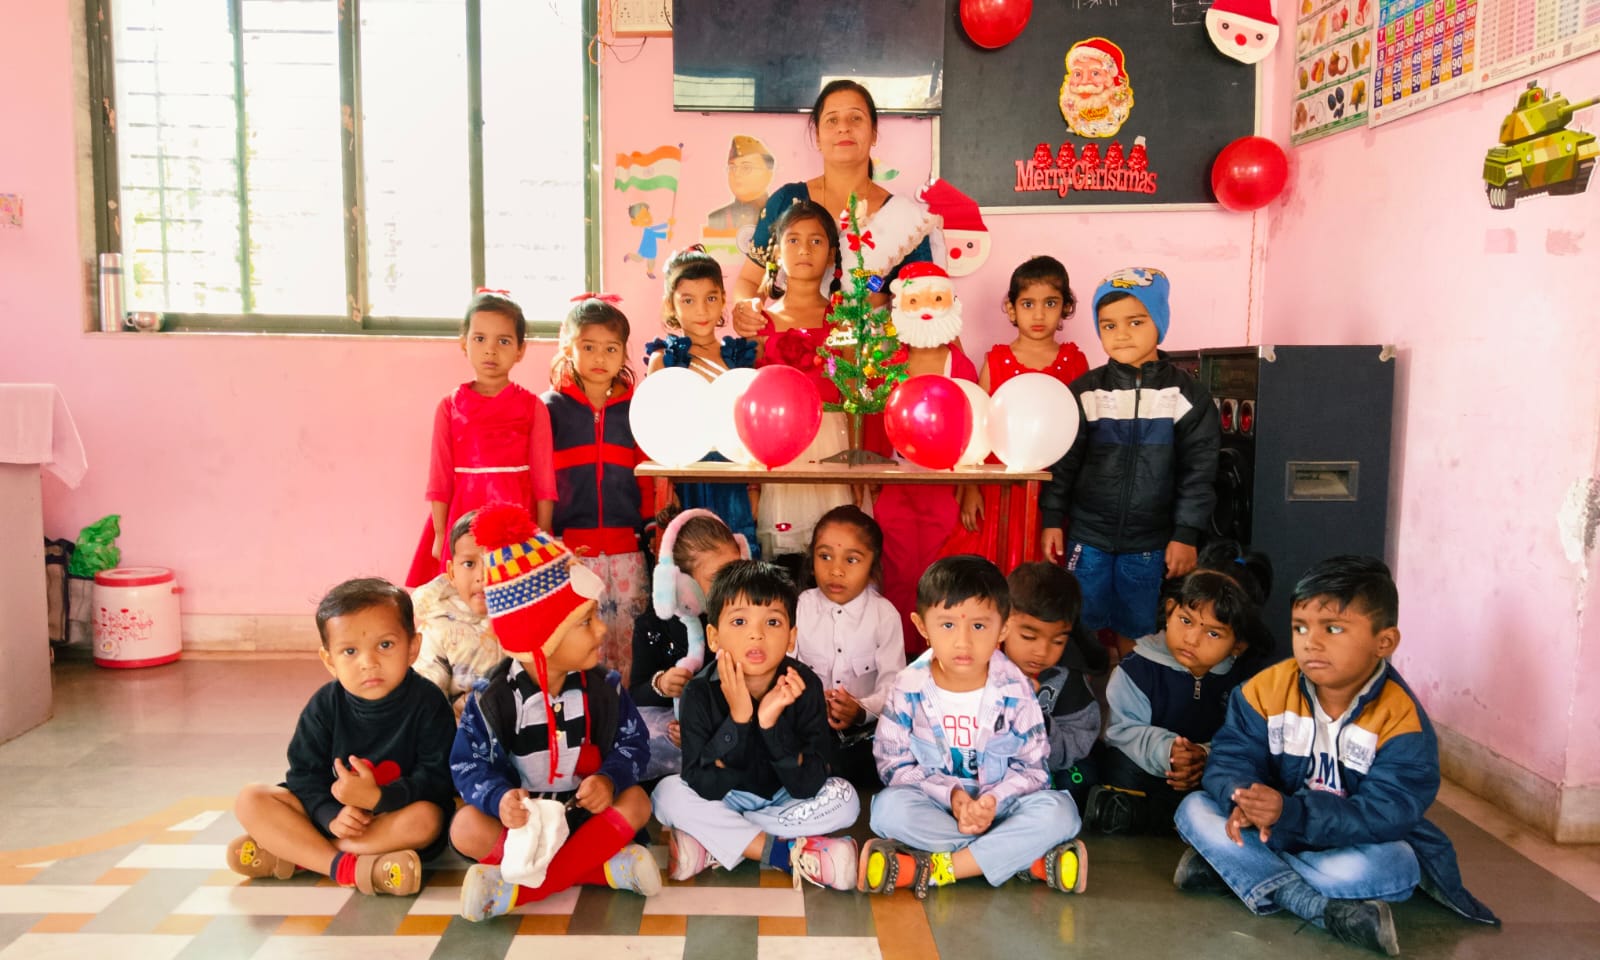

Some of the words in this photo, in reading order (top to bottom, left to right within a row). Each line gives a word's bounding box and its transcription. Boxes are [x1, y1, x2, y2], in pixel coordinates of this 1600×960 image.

[1379, 30, 1383, 40] 7
[1396, 20, 1403, 32] 27
[1406, 16, 1412, 27] 37
[1415, 10, 1422, 21] 47
[1425, 5, 1433, 17] 57
[1435, 0, 1443, 13] 67
[1379, 50, 1384, 61] 8
[1415, 31, 1424, 43] 48
[1425, 27, 1433, 39] 58
[1435, 21, 1444, 34] 68
[1446, 16, 1454, 29] 78
[1377, 70, 1381, 80] 9
[1393, 61, 1401, 73] 29
[1413, 53, 1421, 64] 49
[1434, 44, 1442, 56] 69
[1453, 34, 1462, 47] 89
[1464, 29, 1474, 42] 99
[1393, 82, 1401, 94] 30
[1412, 76, 1420, 86] 50
[1432, 66, 1440, 78] 70
[1452, 57, 1461, 70] 90
[1015, 160, 1072, 198] Merry
[1072, 161, 1158, 194] Christmas
